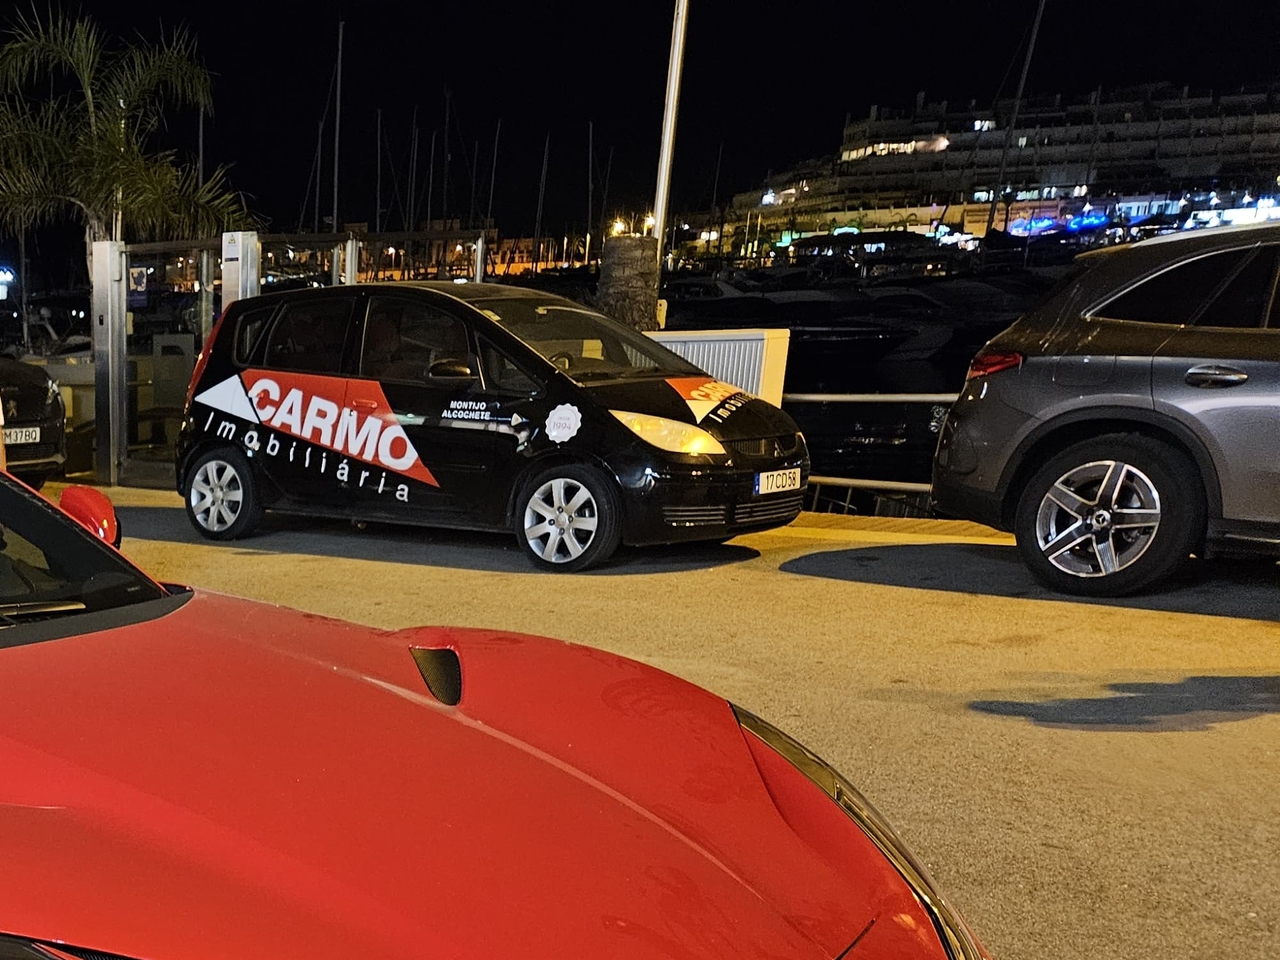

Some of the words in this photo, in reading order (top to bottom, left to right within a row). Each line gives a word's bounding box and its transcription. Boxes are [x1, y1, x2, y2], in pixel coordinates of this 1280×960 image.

[248, 378, 419, 471] CARMO
[441, 409, 491, 420] ALCOCHETE
[450, 400, 487, 410] MONTIJO
[204, 411, 409, 503] Imobiliária
